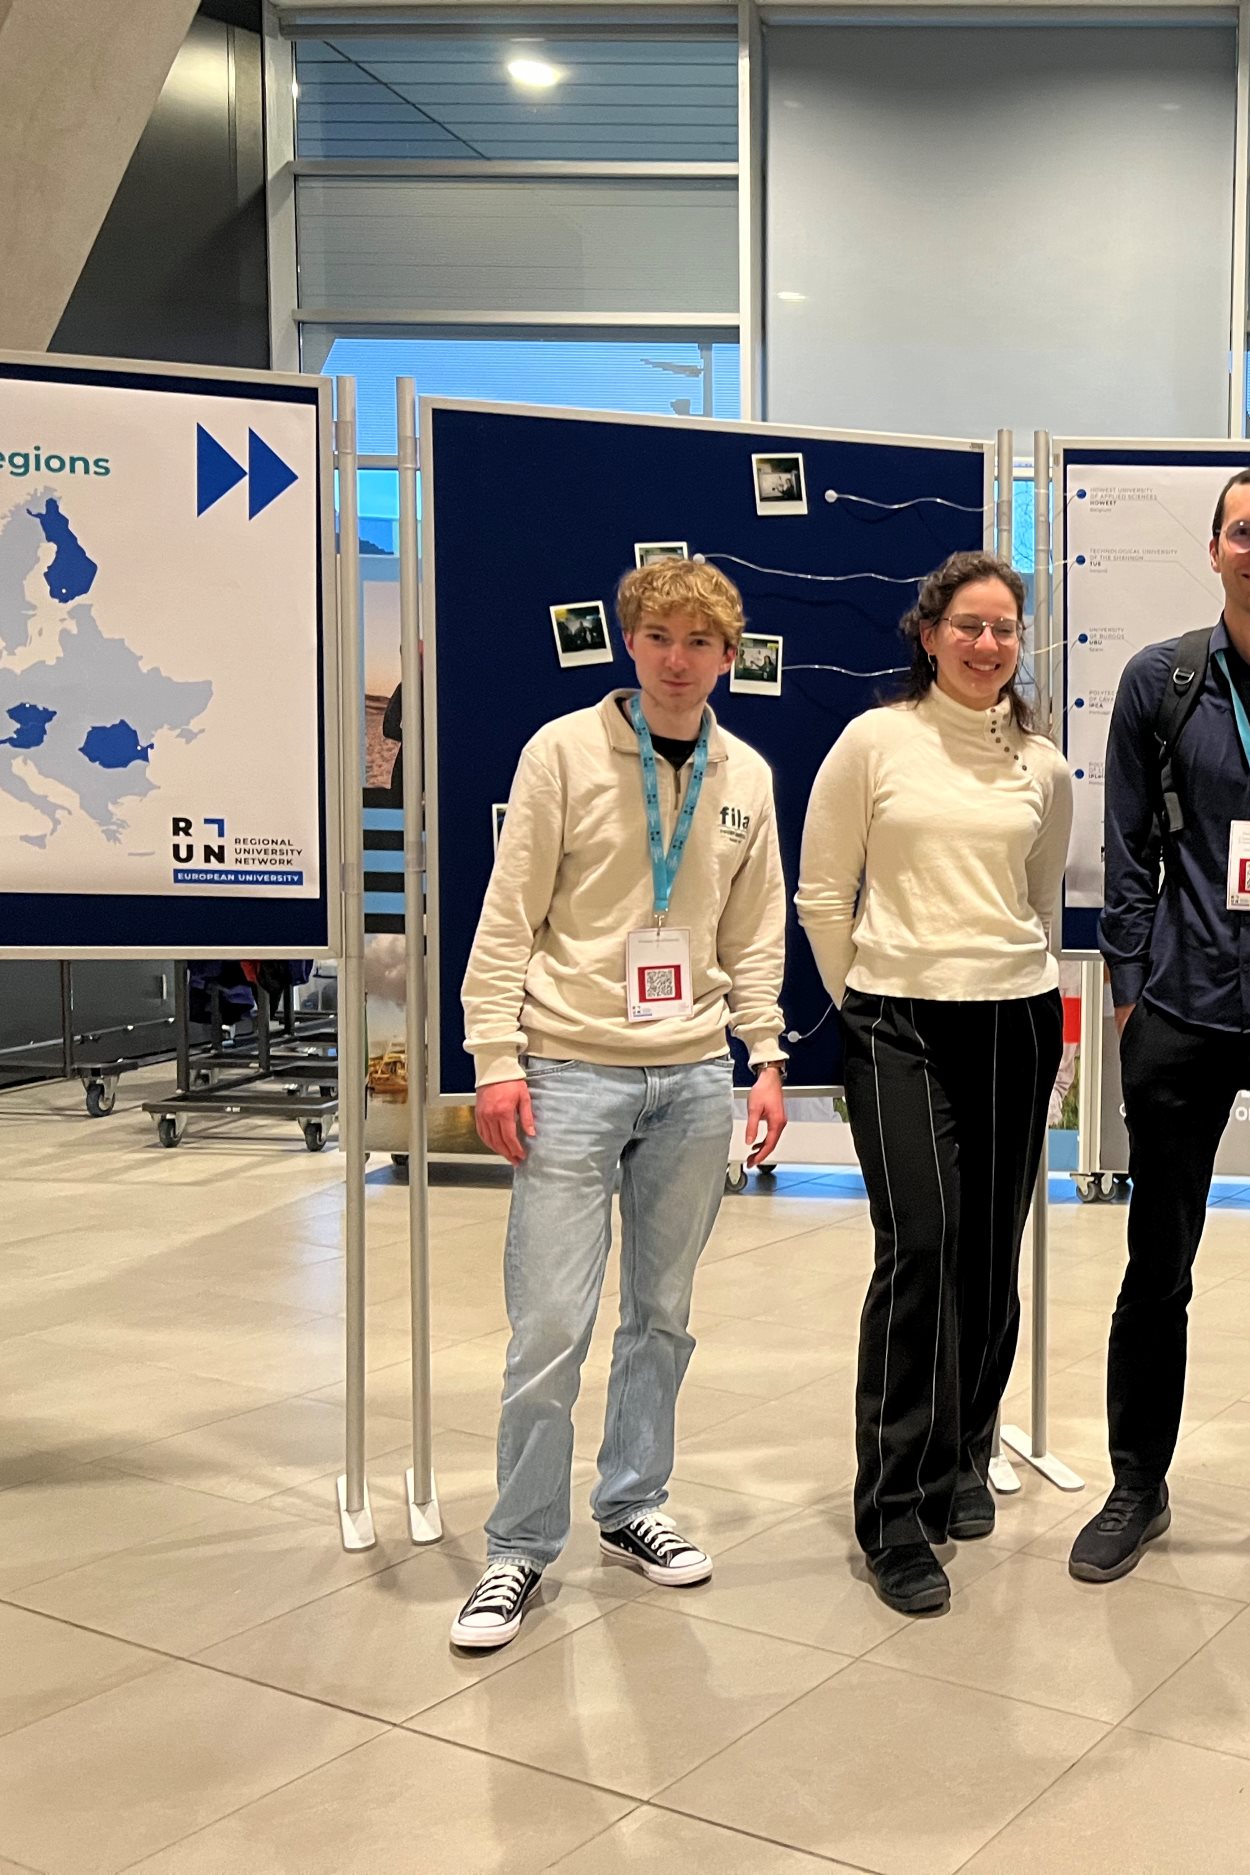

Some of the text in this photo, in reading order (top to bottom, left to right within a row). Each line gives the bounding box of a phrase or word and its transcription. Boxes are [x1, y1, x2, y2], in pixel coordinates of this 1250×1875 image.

[0, 446, 111, 477] gions
[720, 806, 750, 829] fila
[172, 817, 193, 837] R
[234, 838, 294, 846] REGIONAL
[234, 848, 303, 856] UNIVERSITY
[234, 858, 293, 866] NETWORK
[178, 873, 299, 882] EUROPEAN UNIVERSITY
